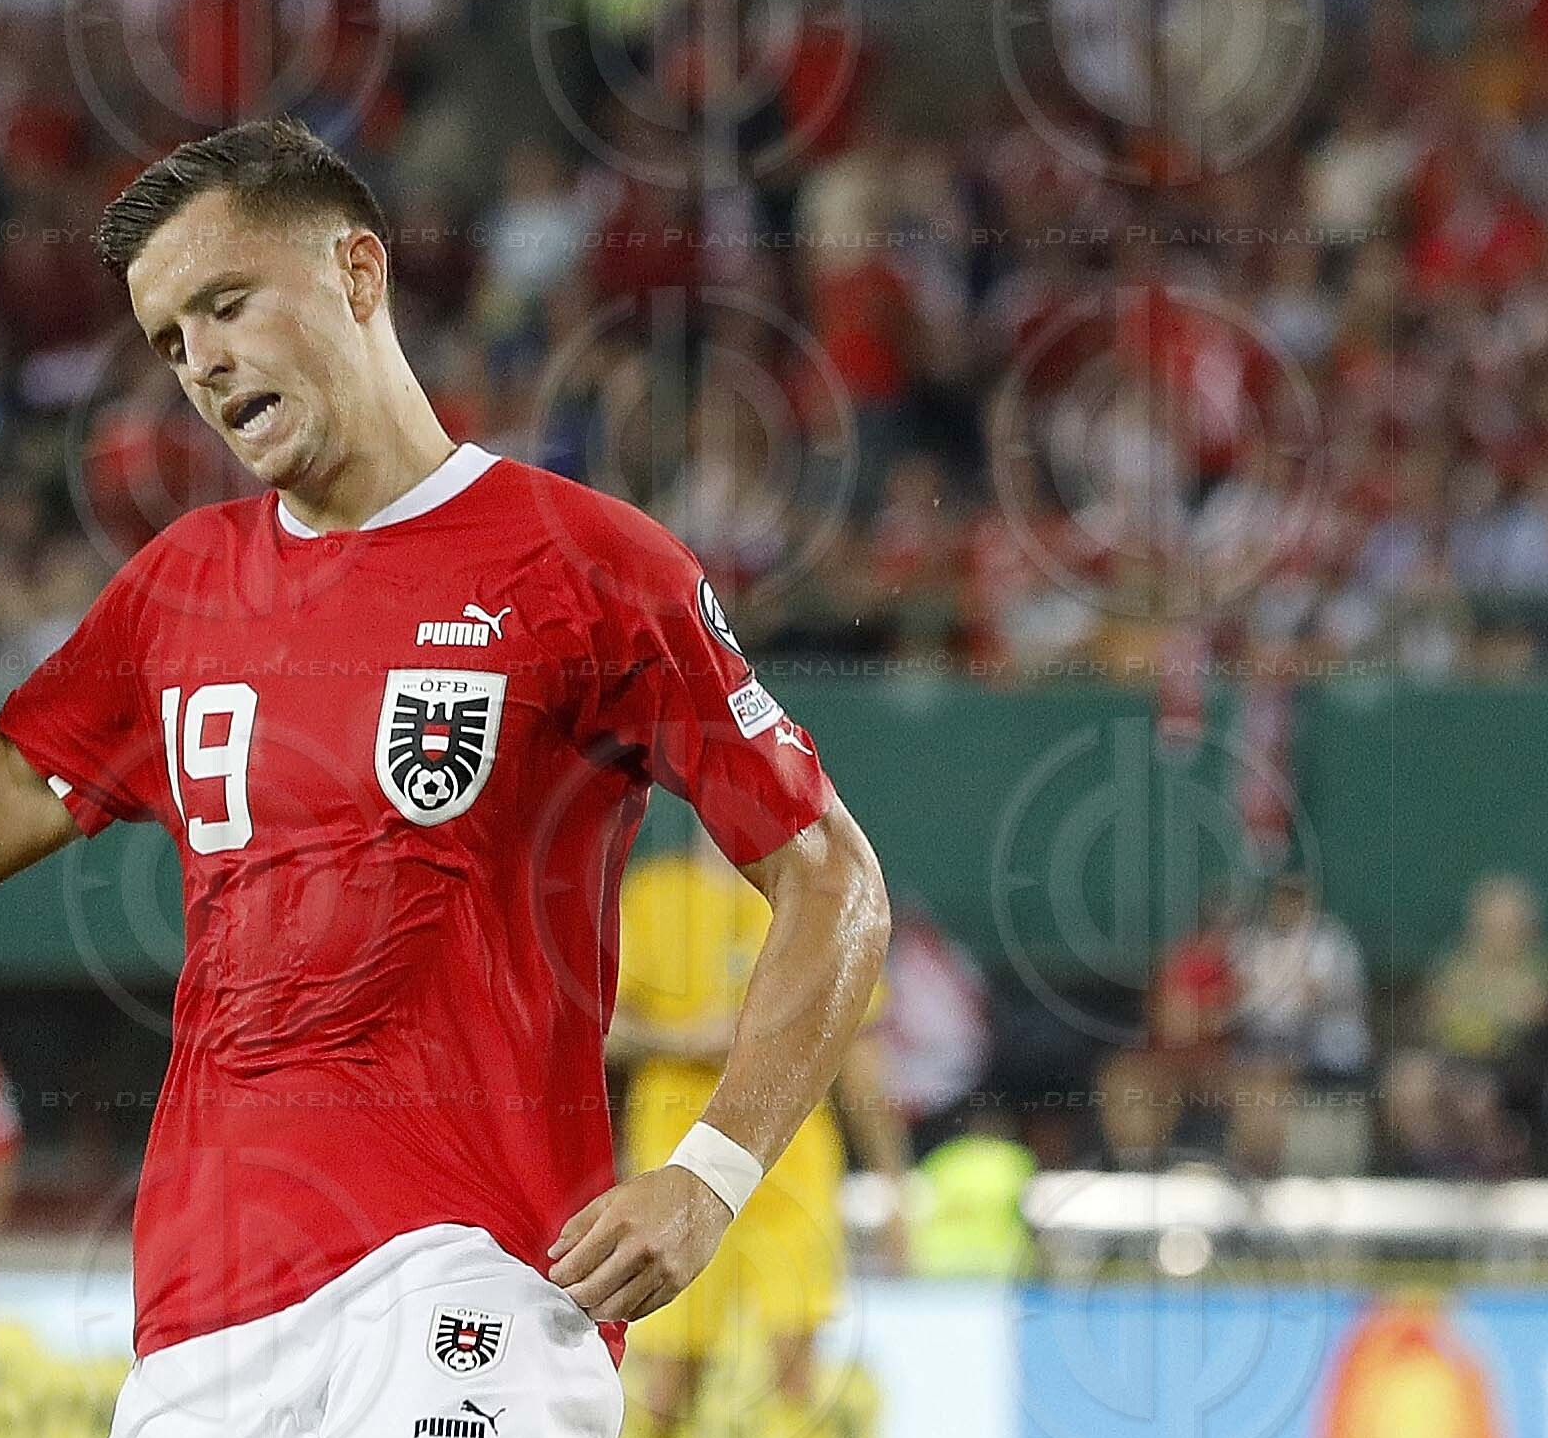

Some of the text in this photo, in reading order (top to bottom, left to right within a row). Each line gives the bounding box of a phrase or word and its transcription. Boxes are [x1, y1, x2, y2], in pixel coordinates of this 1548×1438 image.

[416, 621, 490, 648] PUMA
[420, 677, 468, 694] ÖFB
[161, 682, 259, 855] 19
